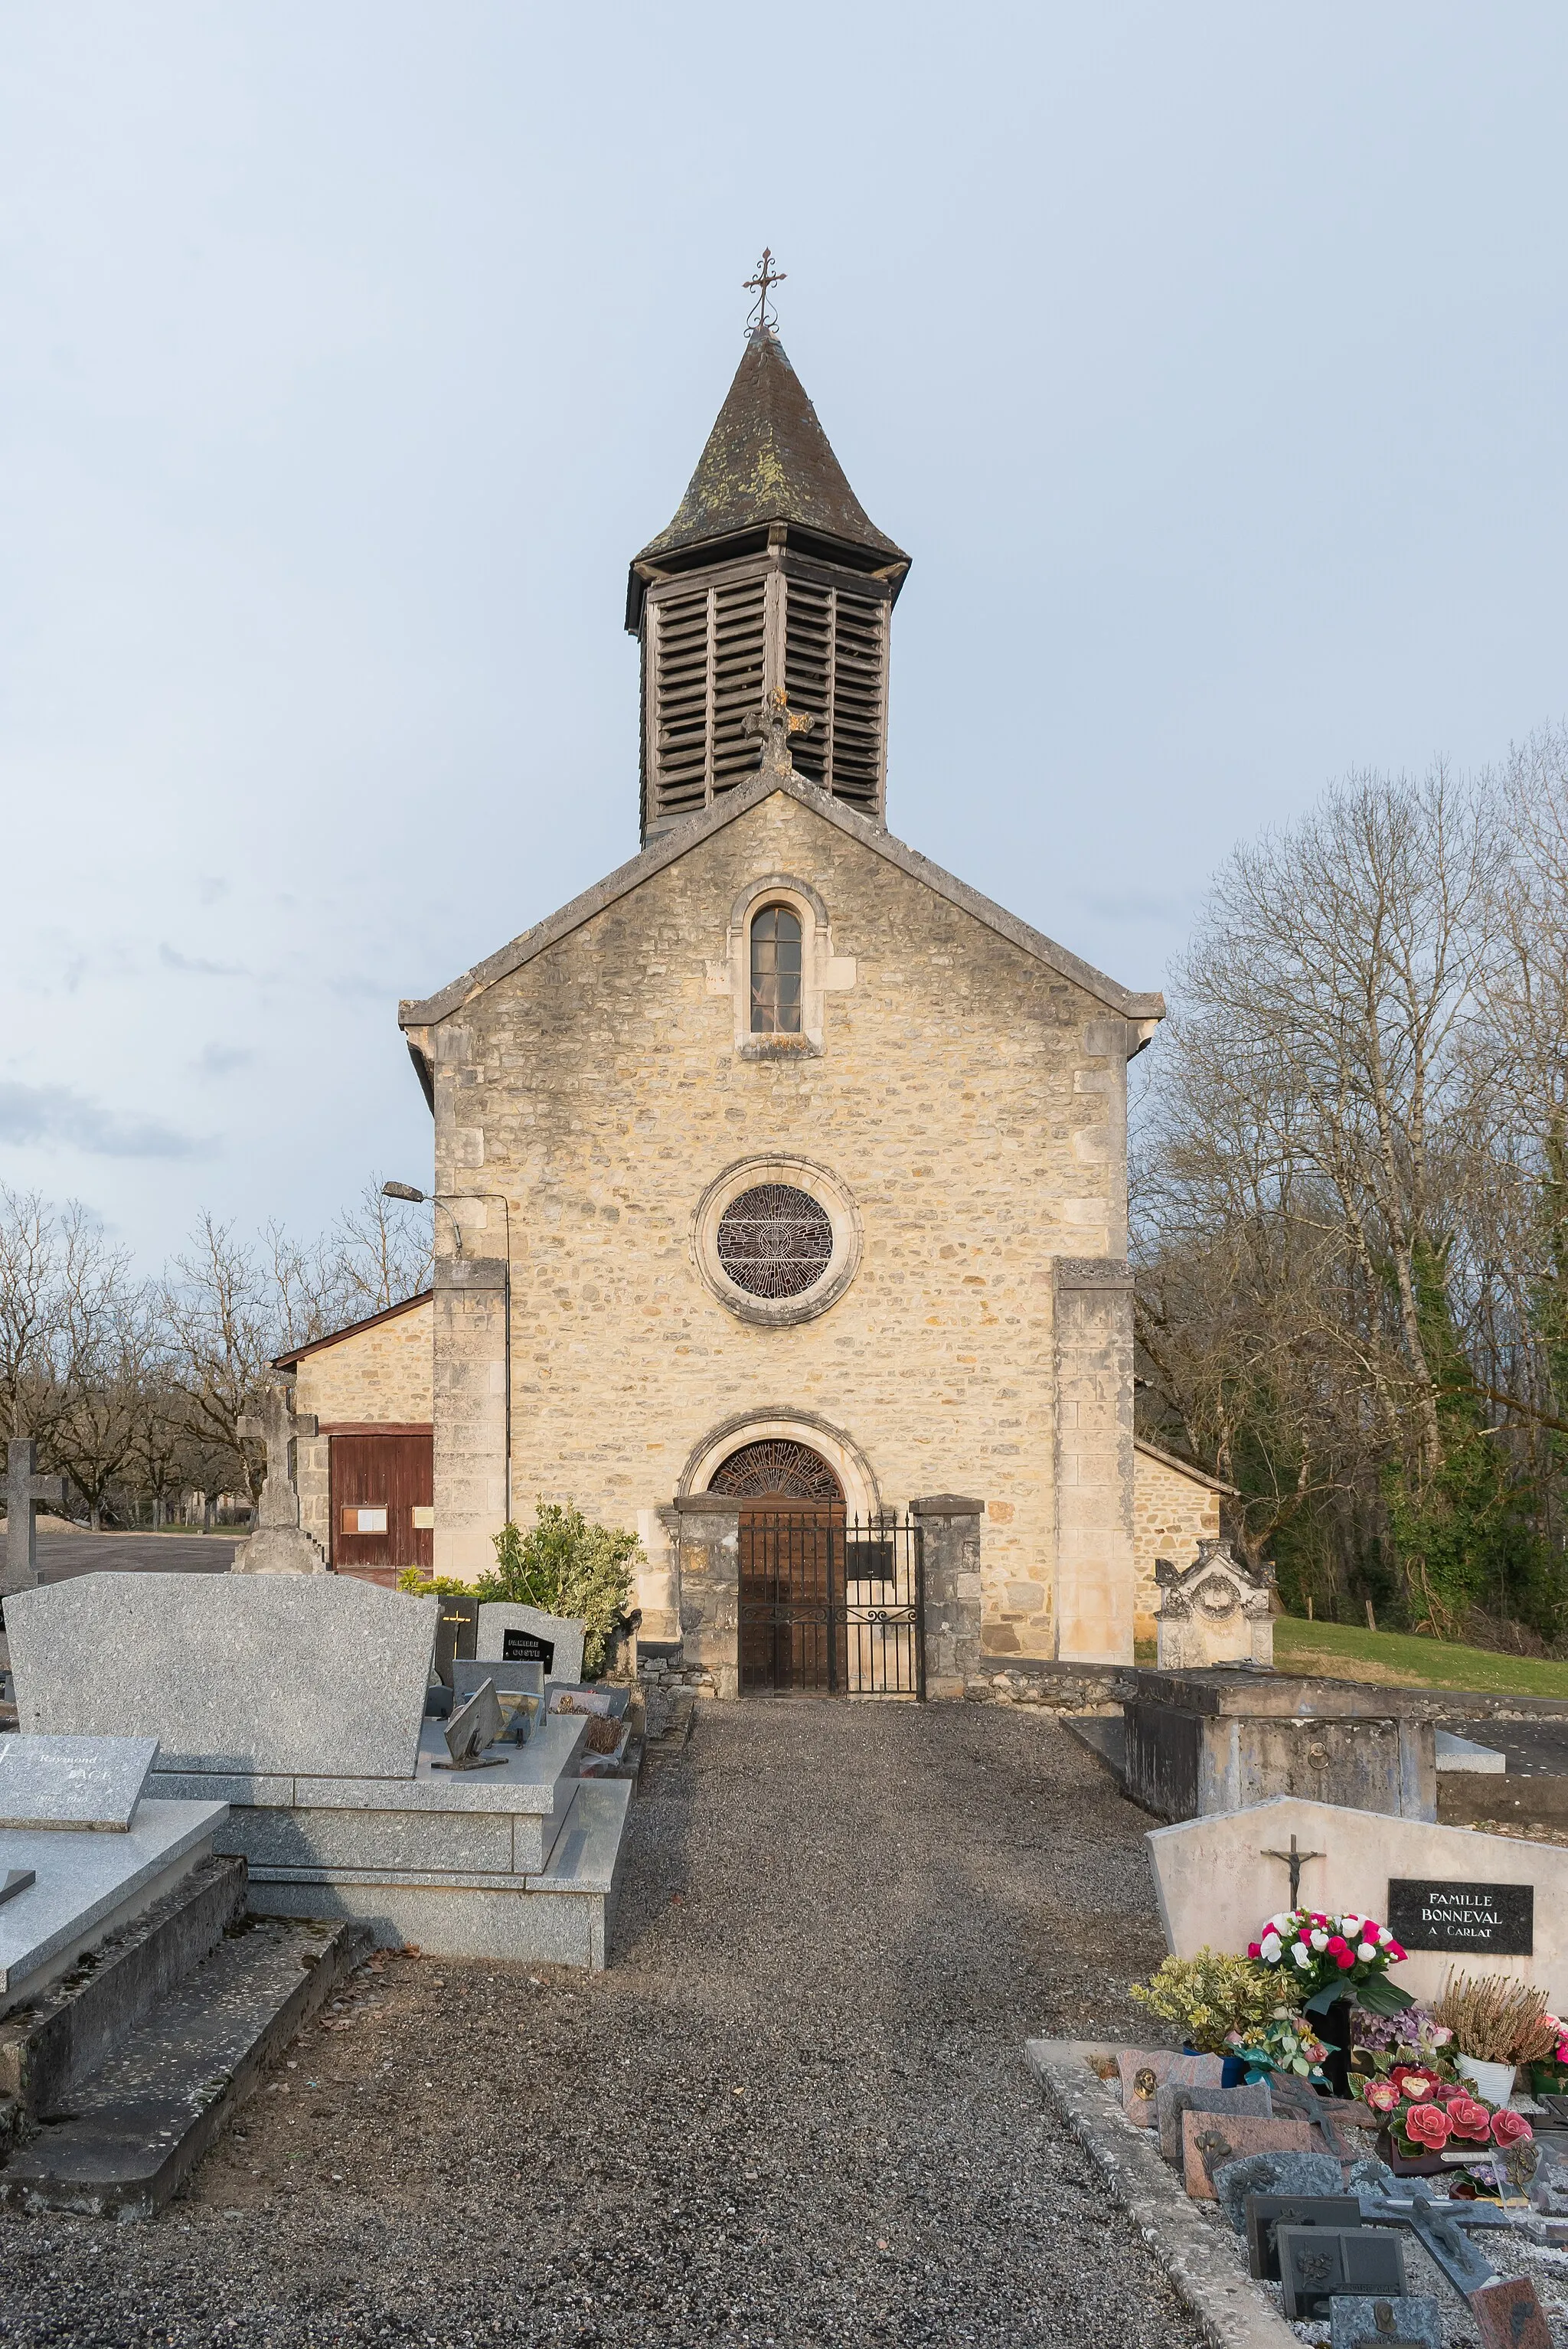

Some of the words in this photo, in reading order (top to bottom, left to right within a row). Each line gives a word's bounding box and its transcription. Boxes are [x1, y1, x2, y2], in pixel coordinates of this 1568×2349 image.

[39, 1754, 97, 1764] Raymond
[1429, 1893, 1492, 1906] FAMILLE
[1422, 1908, 1503, 1925] BONNEVAL
[1429, 1926, 1437, 1935] A
